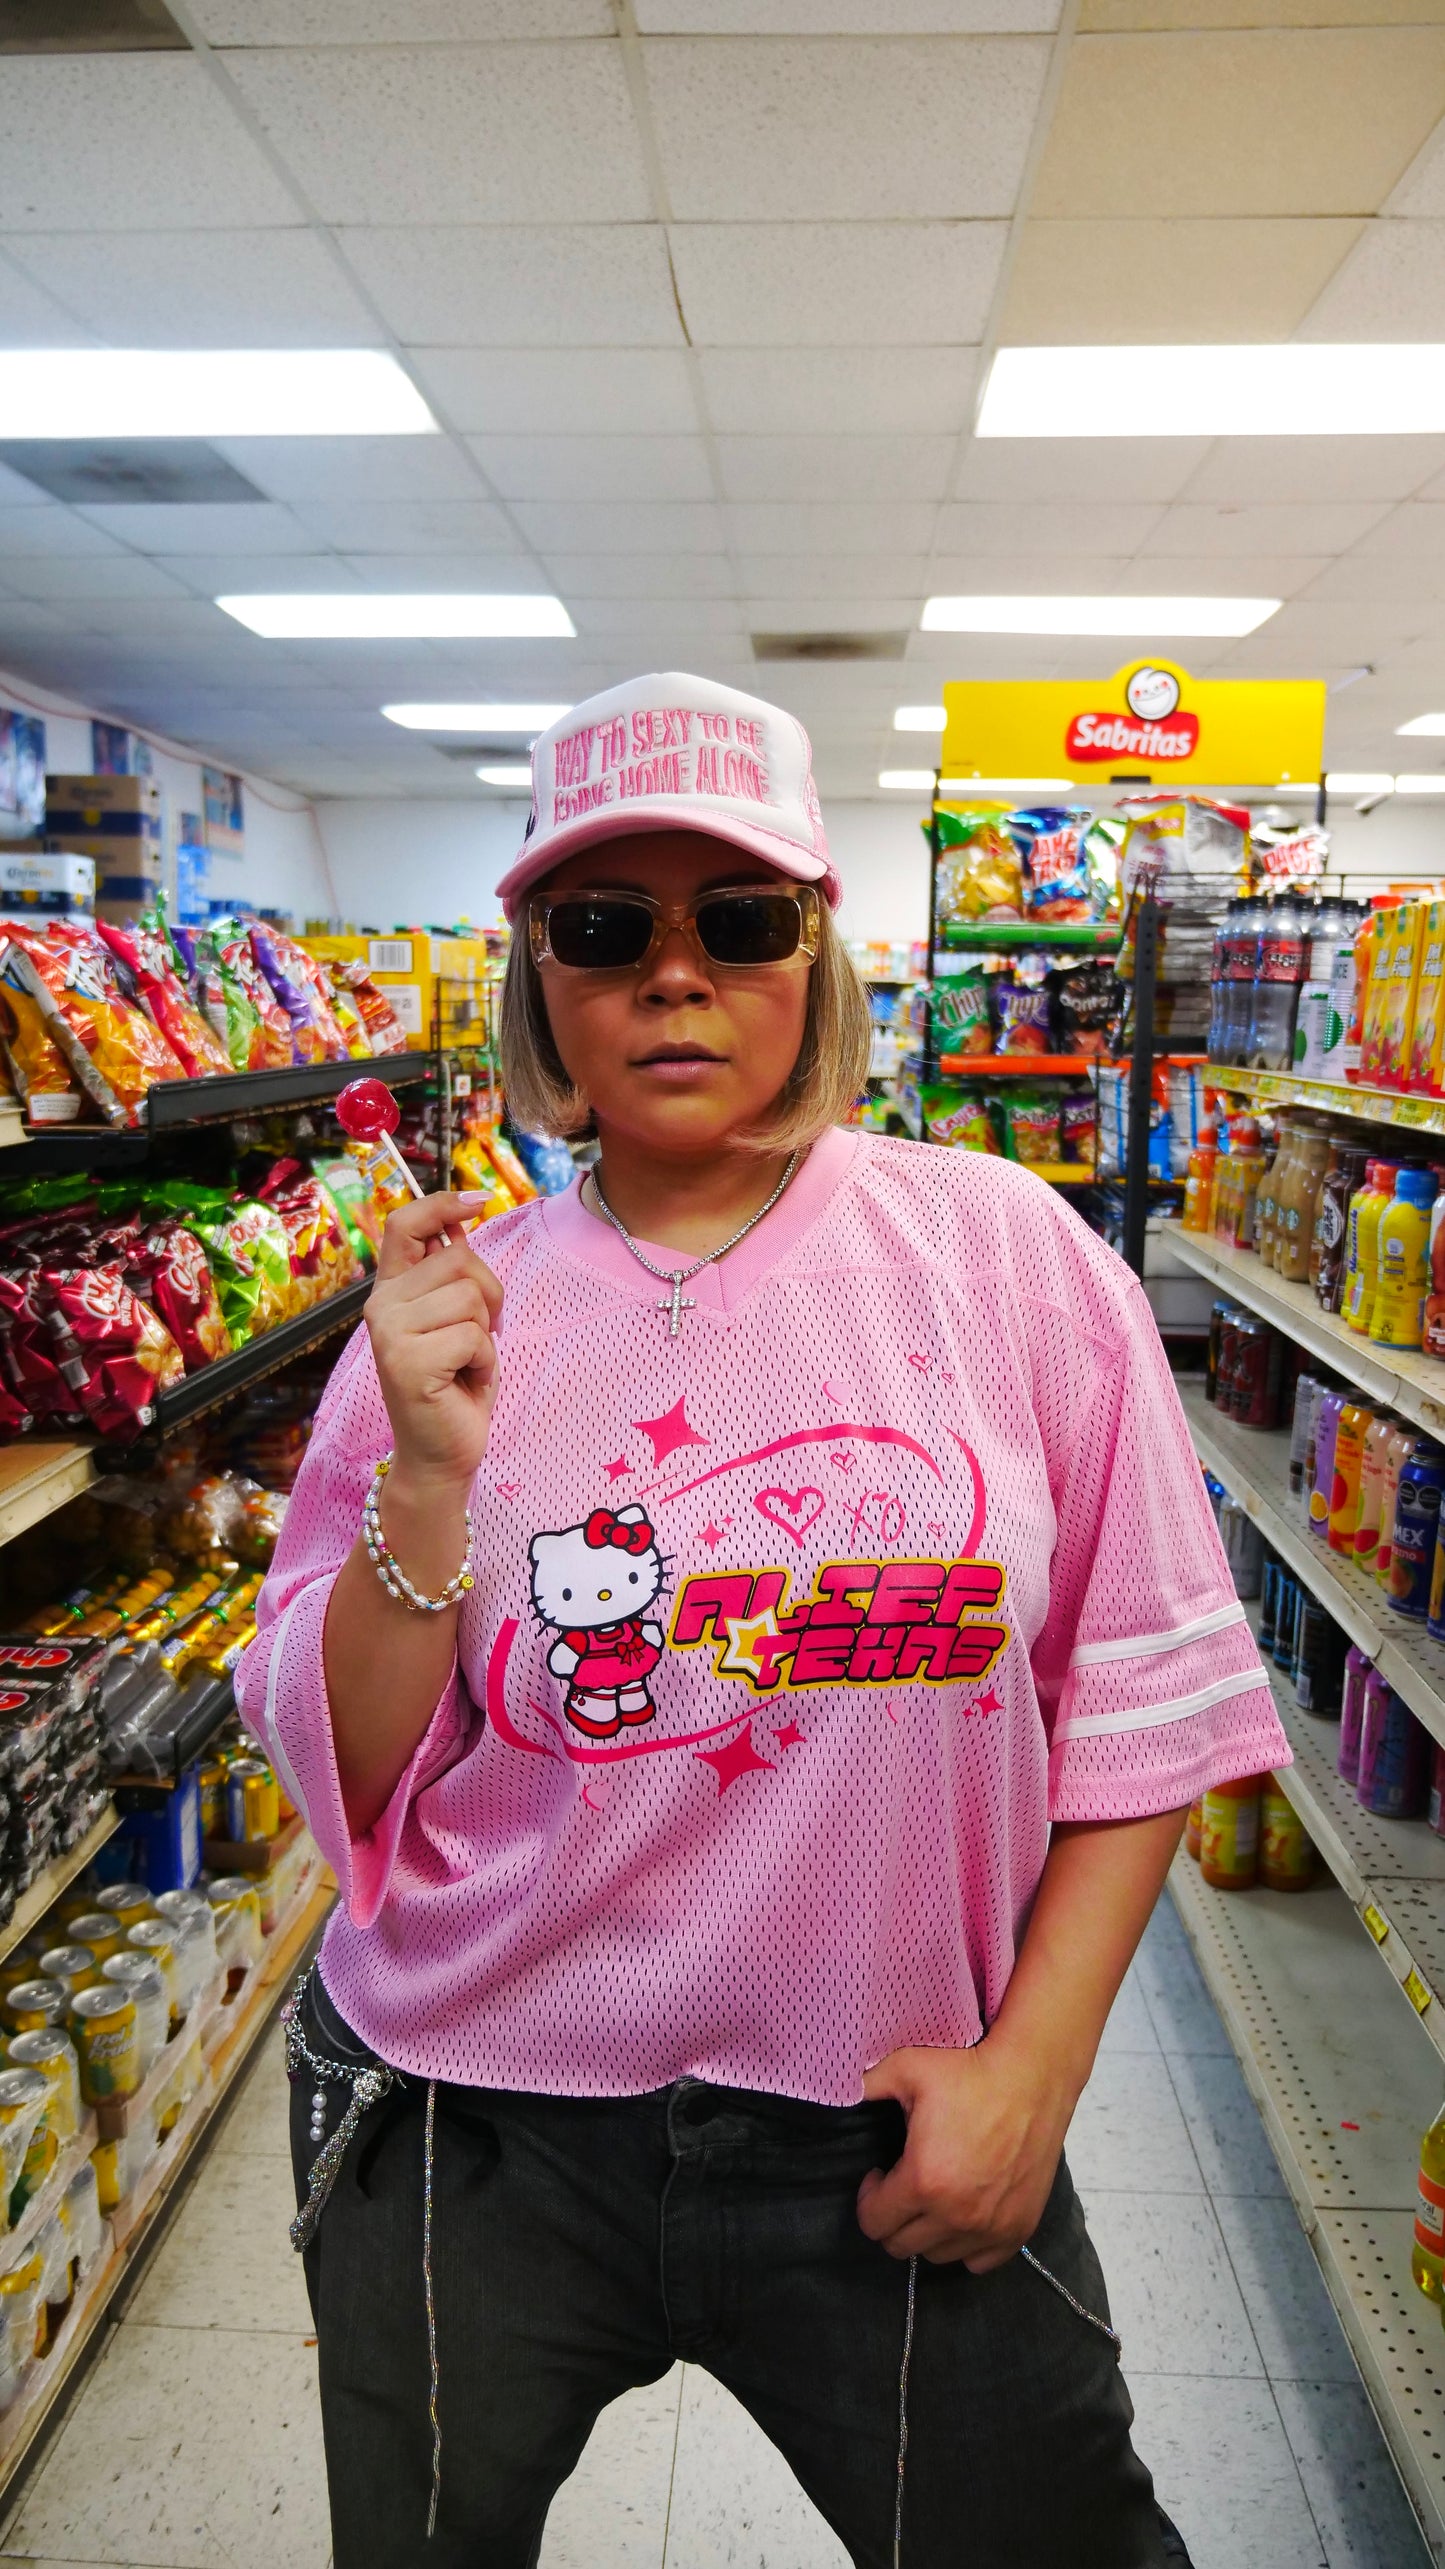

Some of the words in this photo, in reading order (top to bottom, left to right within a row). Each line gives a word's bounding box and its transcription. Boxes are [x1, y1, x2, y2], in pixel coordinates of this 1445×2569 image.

[554, 726, 595, 788] WAY
[596, 714, 627, 774] TO
[631, 708, 692, 759] SEXY
[697, 711, 730, 743] TO
[735, 717, 769, 763] BE
[1073, 714, 1192, 757] Sabritas
[553, 777, 615, 828] GOING
[619, 750, 693, 800] HOME
[695, 746, 777, 808] ALONE
[939, 985, 987, 1029] Chip
[843, 1488, 906, 1549] XO
[671, 1562, 1006, 1645] ALIEF
[752, 1625, 1007, 1691] TEXAS
